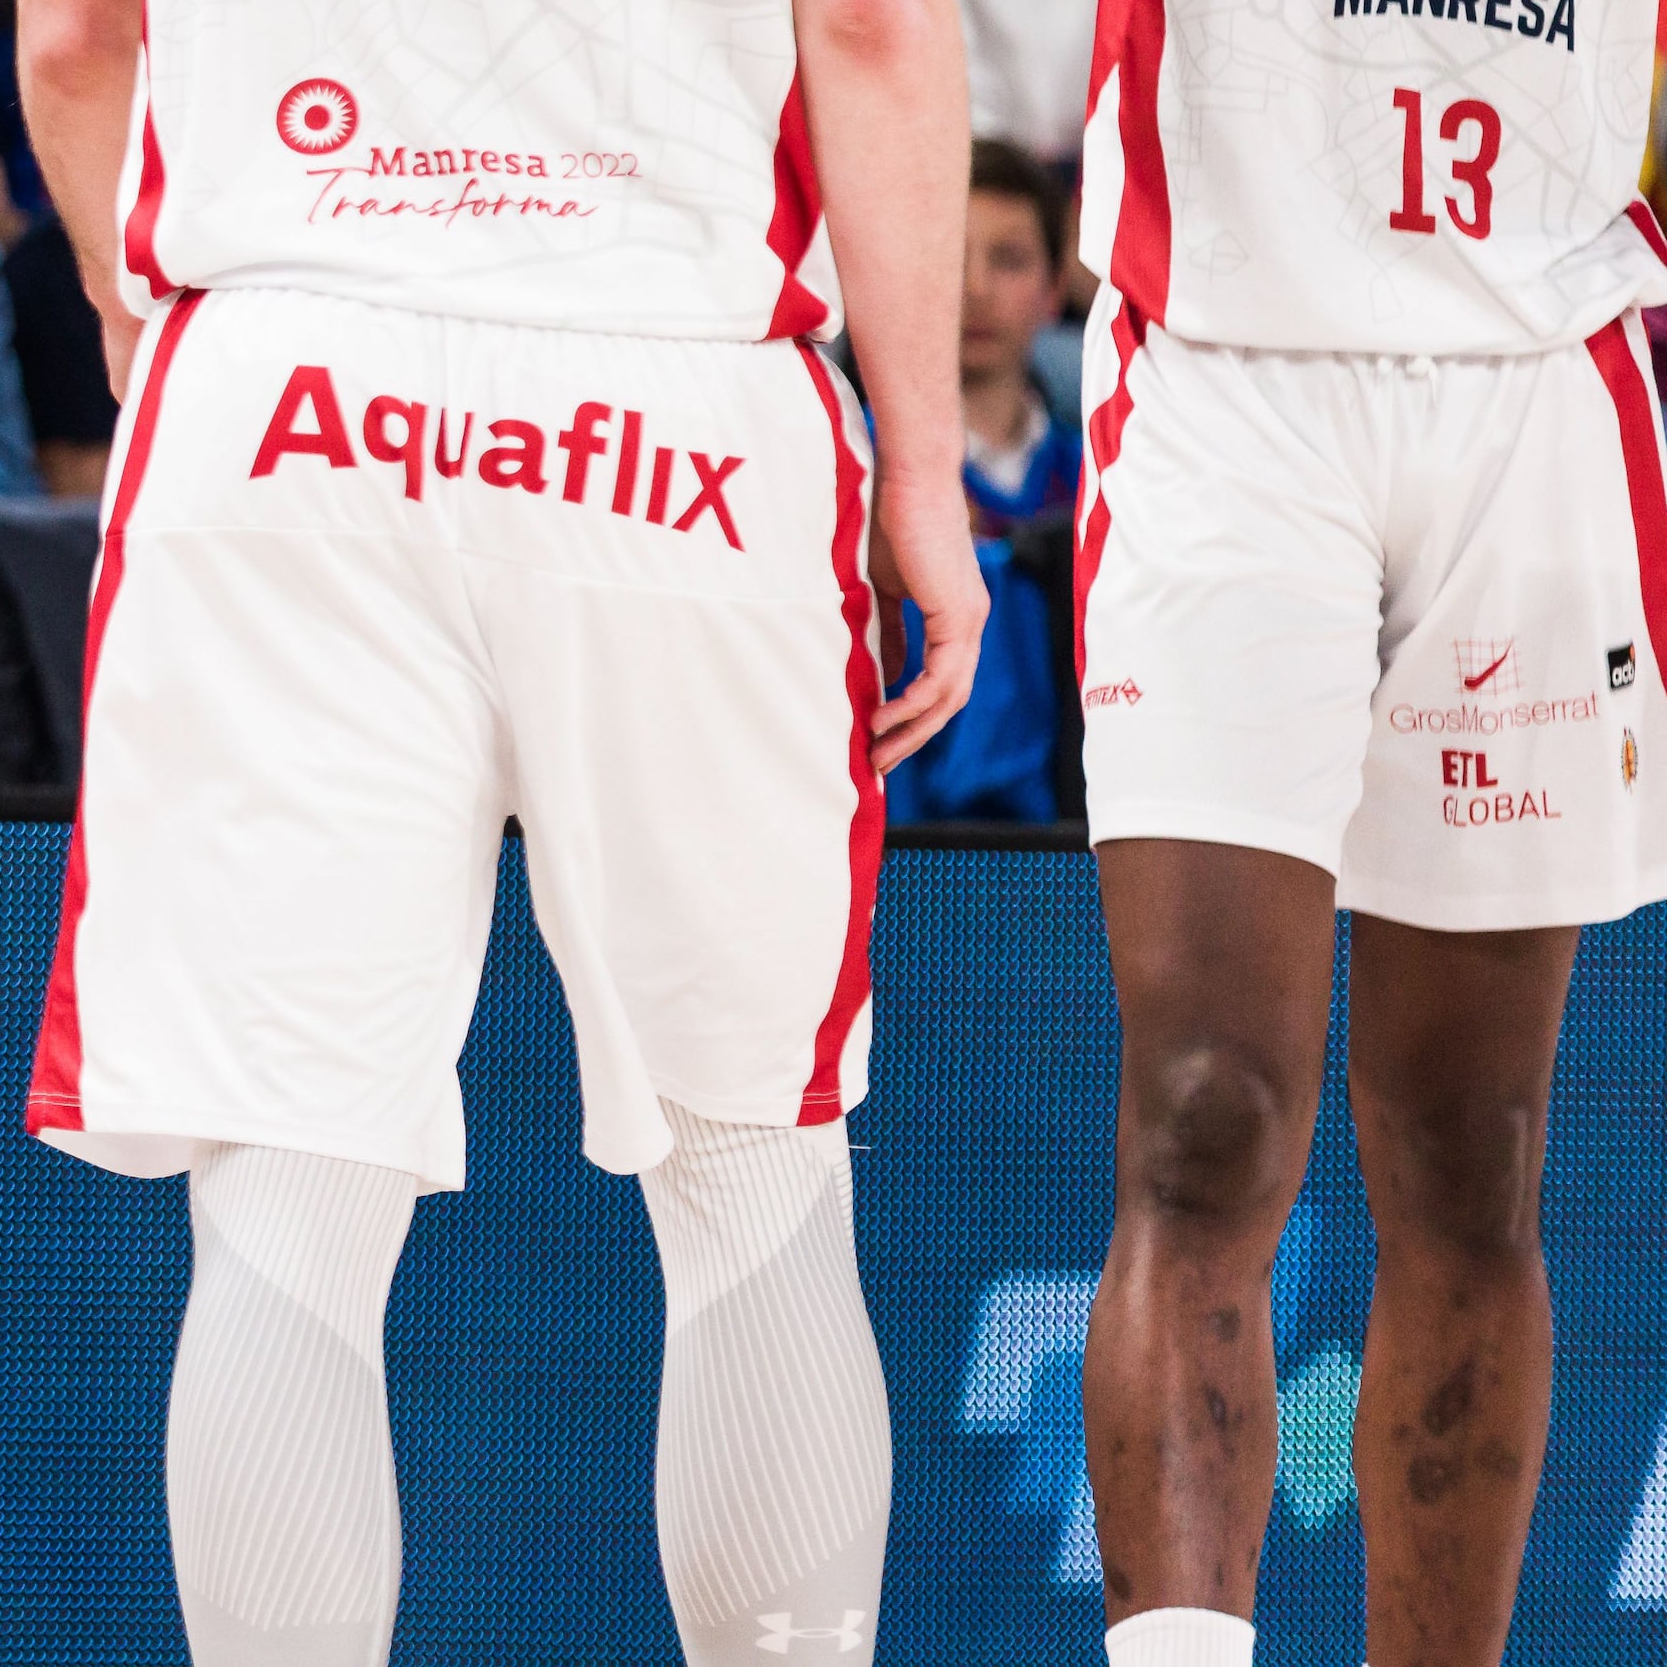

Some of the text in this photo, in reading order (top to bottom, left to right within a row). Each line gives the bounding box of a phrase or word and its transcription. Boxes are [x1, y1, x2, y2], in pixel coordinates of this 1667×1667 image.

[368, 146, 643, 180] Manresa 2022
[1389, 87, 1503, 241] 13
[305, 166, 600, 229] Transforma
[249, 365, 747, 554] Aquaflix
[1390, 690, 1599, 735] GrosMonserrat
[1442, 750, 1498, 789] ETL
[1443, 789, 1563, 828] GLOBAL
